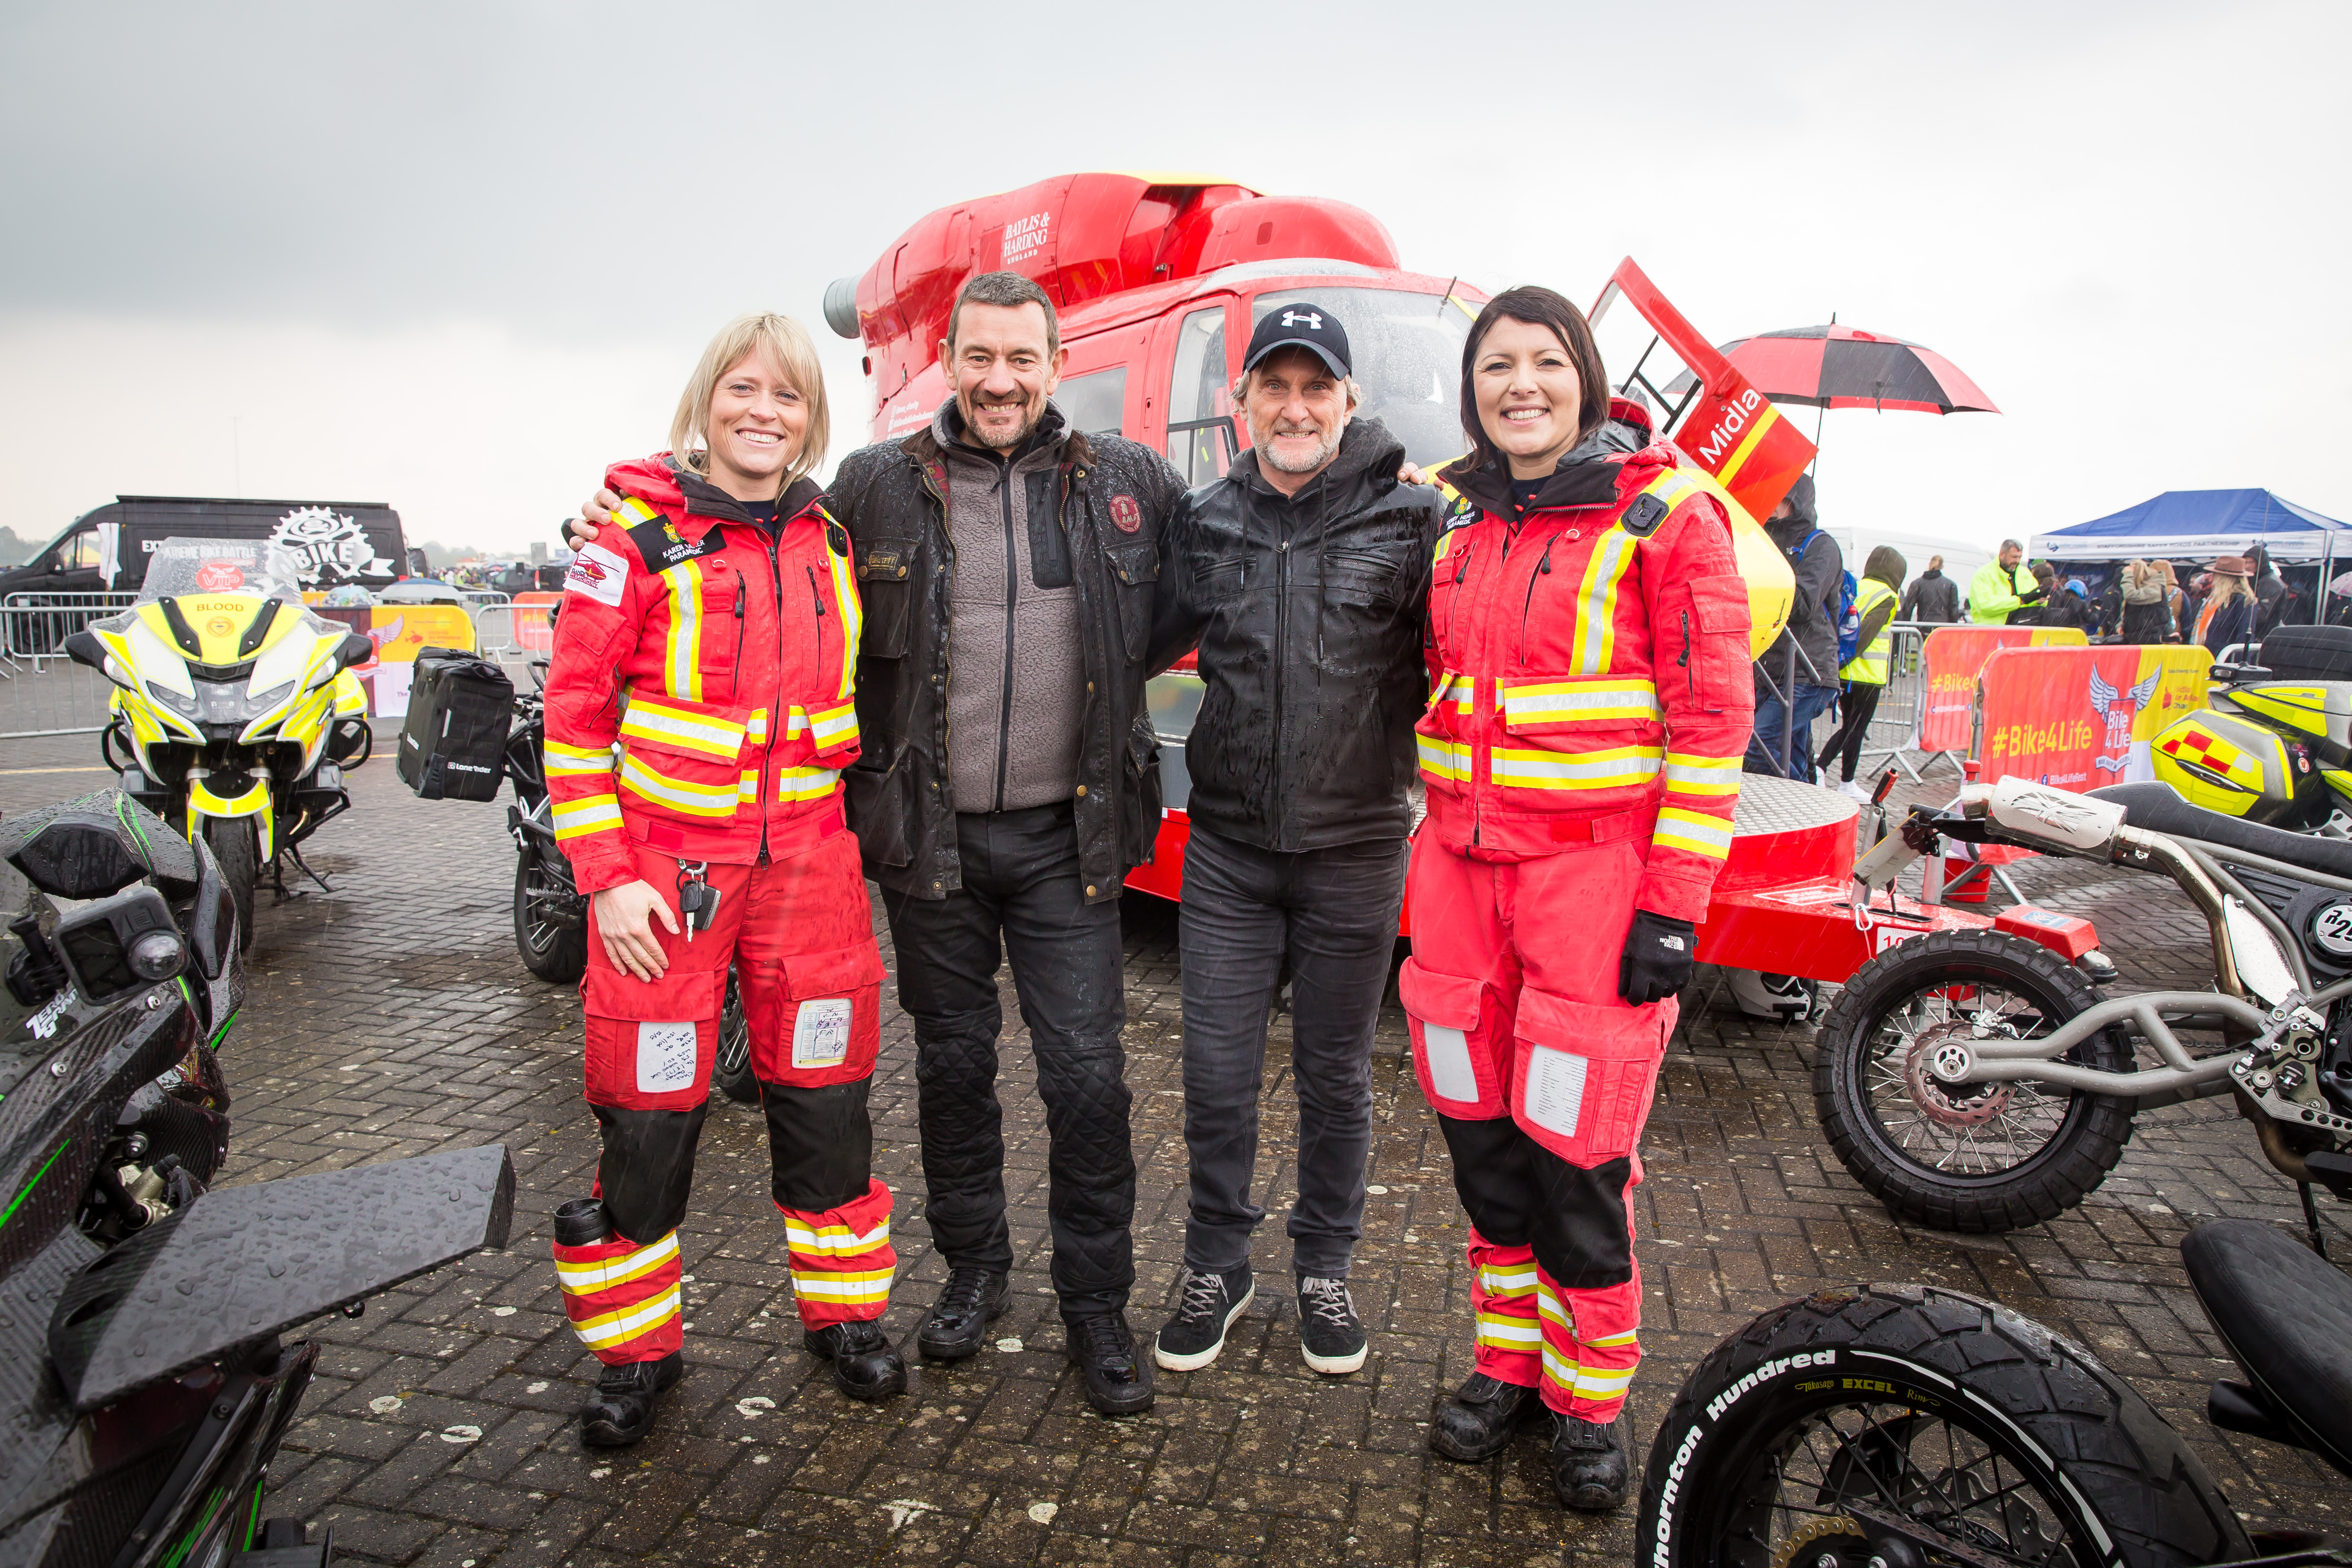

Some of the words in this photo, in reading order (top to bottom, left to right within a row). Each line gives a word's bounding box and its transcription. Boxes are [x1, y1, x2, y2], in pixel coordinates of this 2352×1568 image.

[1005, 214, 1040, 240] BAYLIS
[1040, 211, 1051, 227] &
[1004, 228, 1048, 257] HARDING
[1007, 249, 1038, 265] ENGLAND
[1699, 389, 1761, 465] Midla
[1447, 518, 1471, 530] PARAMEDIC
[221, 545, 258, 559] BATTLE
[292, 542, 355, 569] BIKE
[662, 544, 685, 558] KAREN
[669, 547, 703, 562] PARAMEDIC
[202, 573, 240, 586] VIP
[197, 603, 244, 612] BLOOD
[1992, 720, 2092, 760] #Bike4Life
[2105, 730, 2112, 749] 4
[456, 763, 473, 771] Lone
[1660, 937, 1677, 946] NORTH
[25, 994, 64, 1040] ZERO
[1706, 1350, 1836, 1421] Hundred
[1794, 1380, 1835, 1393] Takasago
[1842, 1378, 1896, 1394] EXCEL
[1907, 1389, 1940, 1406] Rim
[1654, 1425, 1703, 1568] hornton
